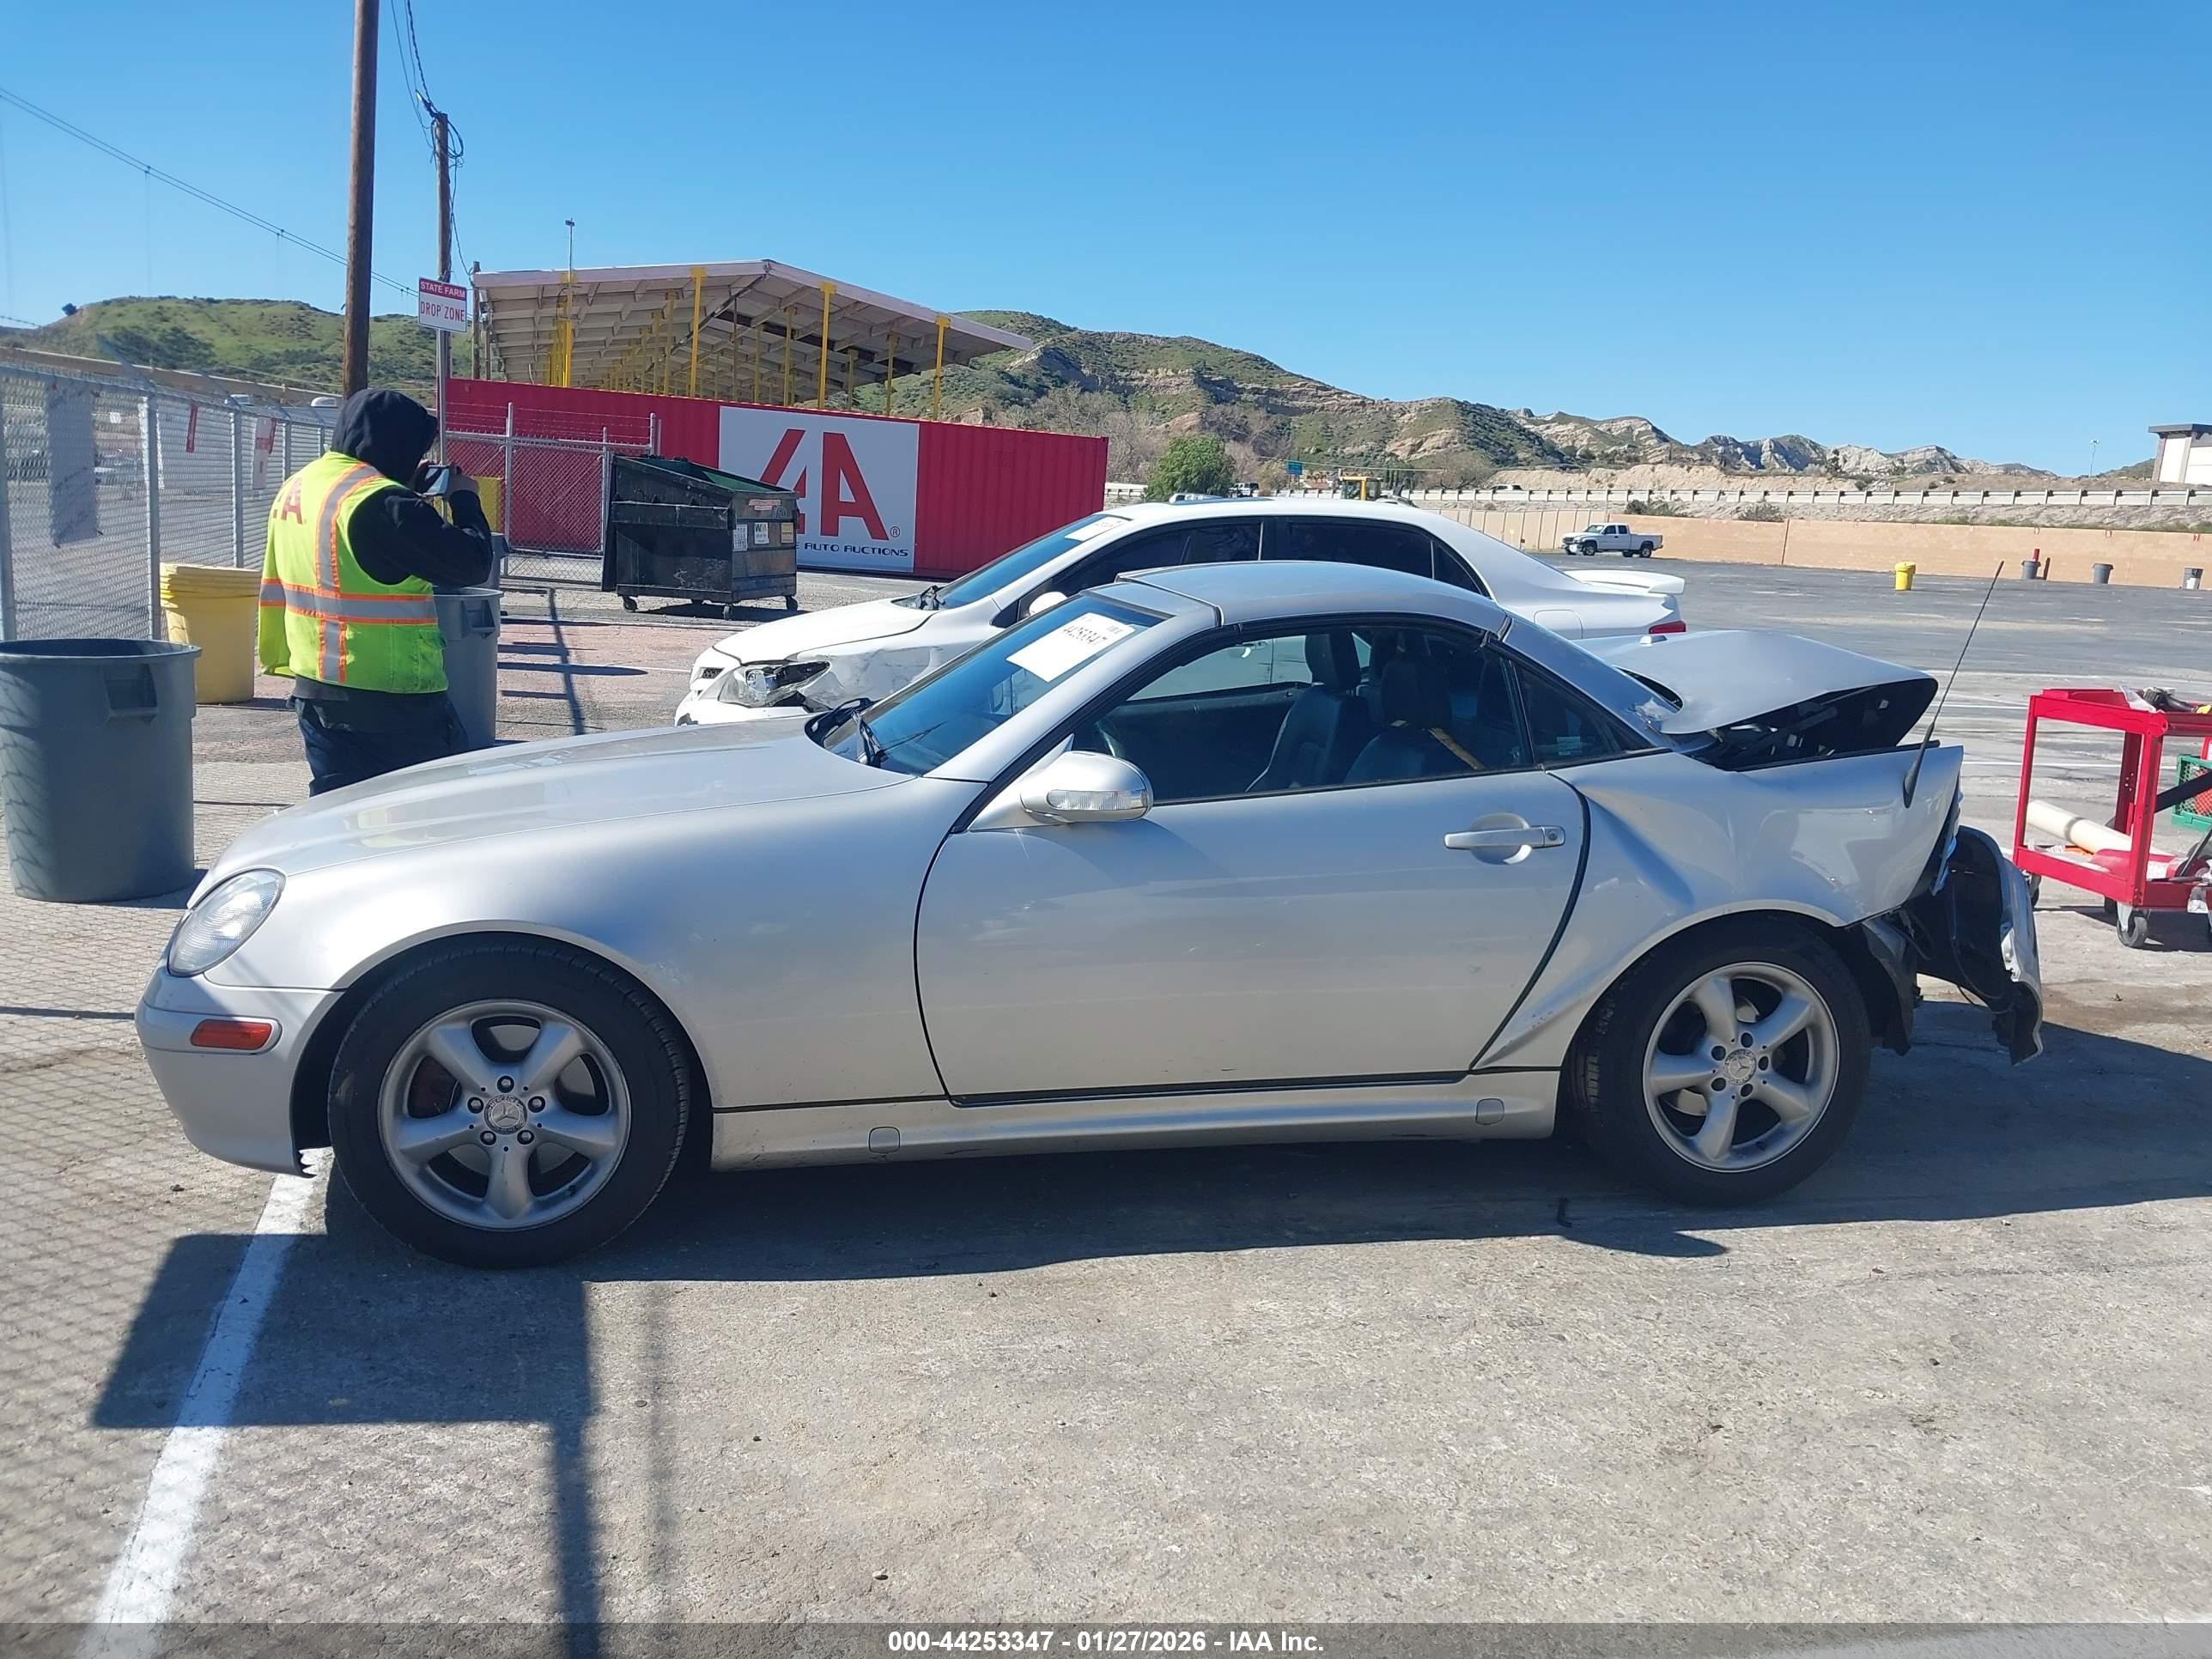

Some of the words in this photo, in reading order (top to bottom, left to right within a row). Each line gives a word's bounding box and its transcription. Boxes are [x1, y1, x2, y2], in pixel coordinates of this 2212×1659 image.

[421, 281, 443, 294] STATE
[444, 287, 465, 298] FARM
[421, 301, 441, 317] DROP
[444, 307, 465, 322] ZONE
[804, 542, 840, 552] AUTO
[843, 545, 909, 557] AUCTIONS
